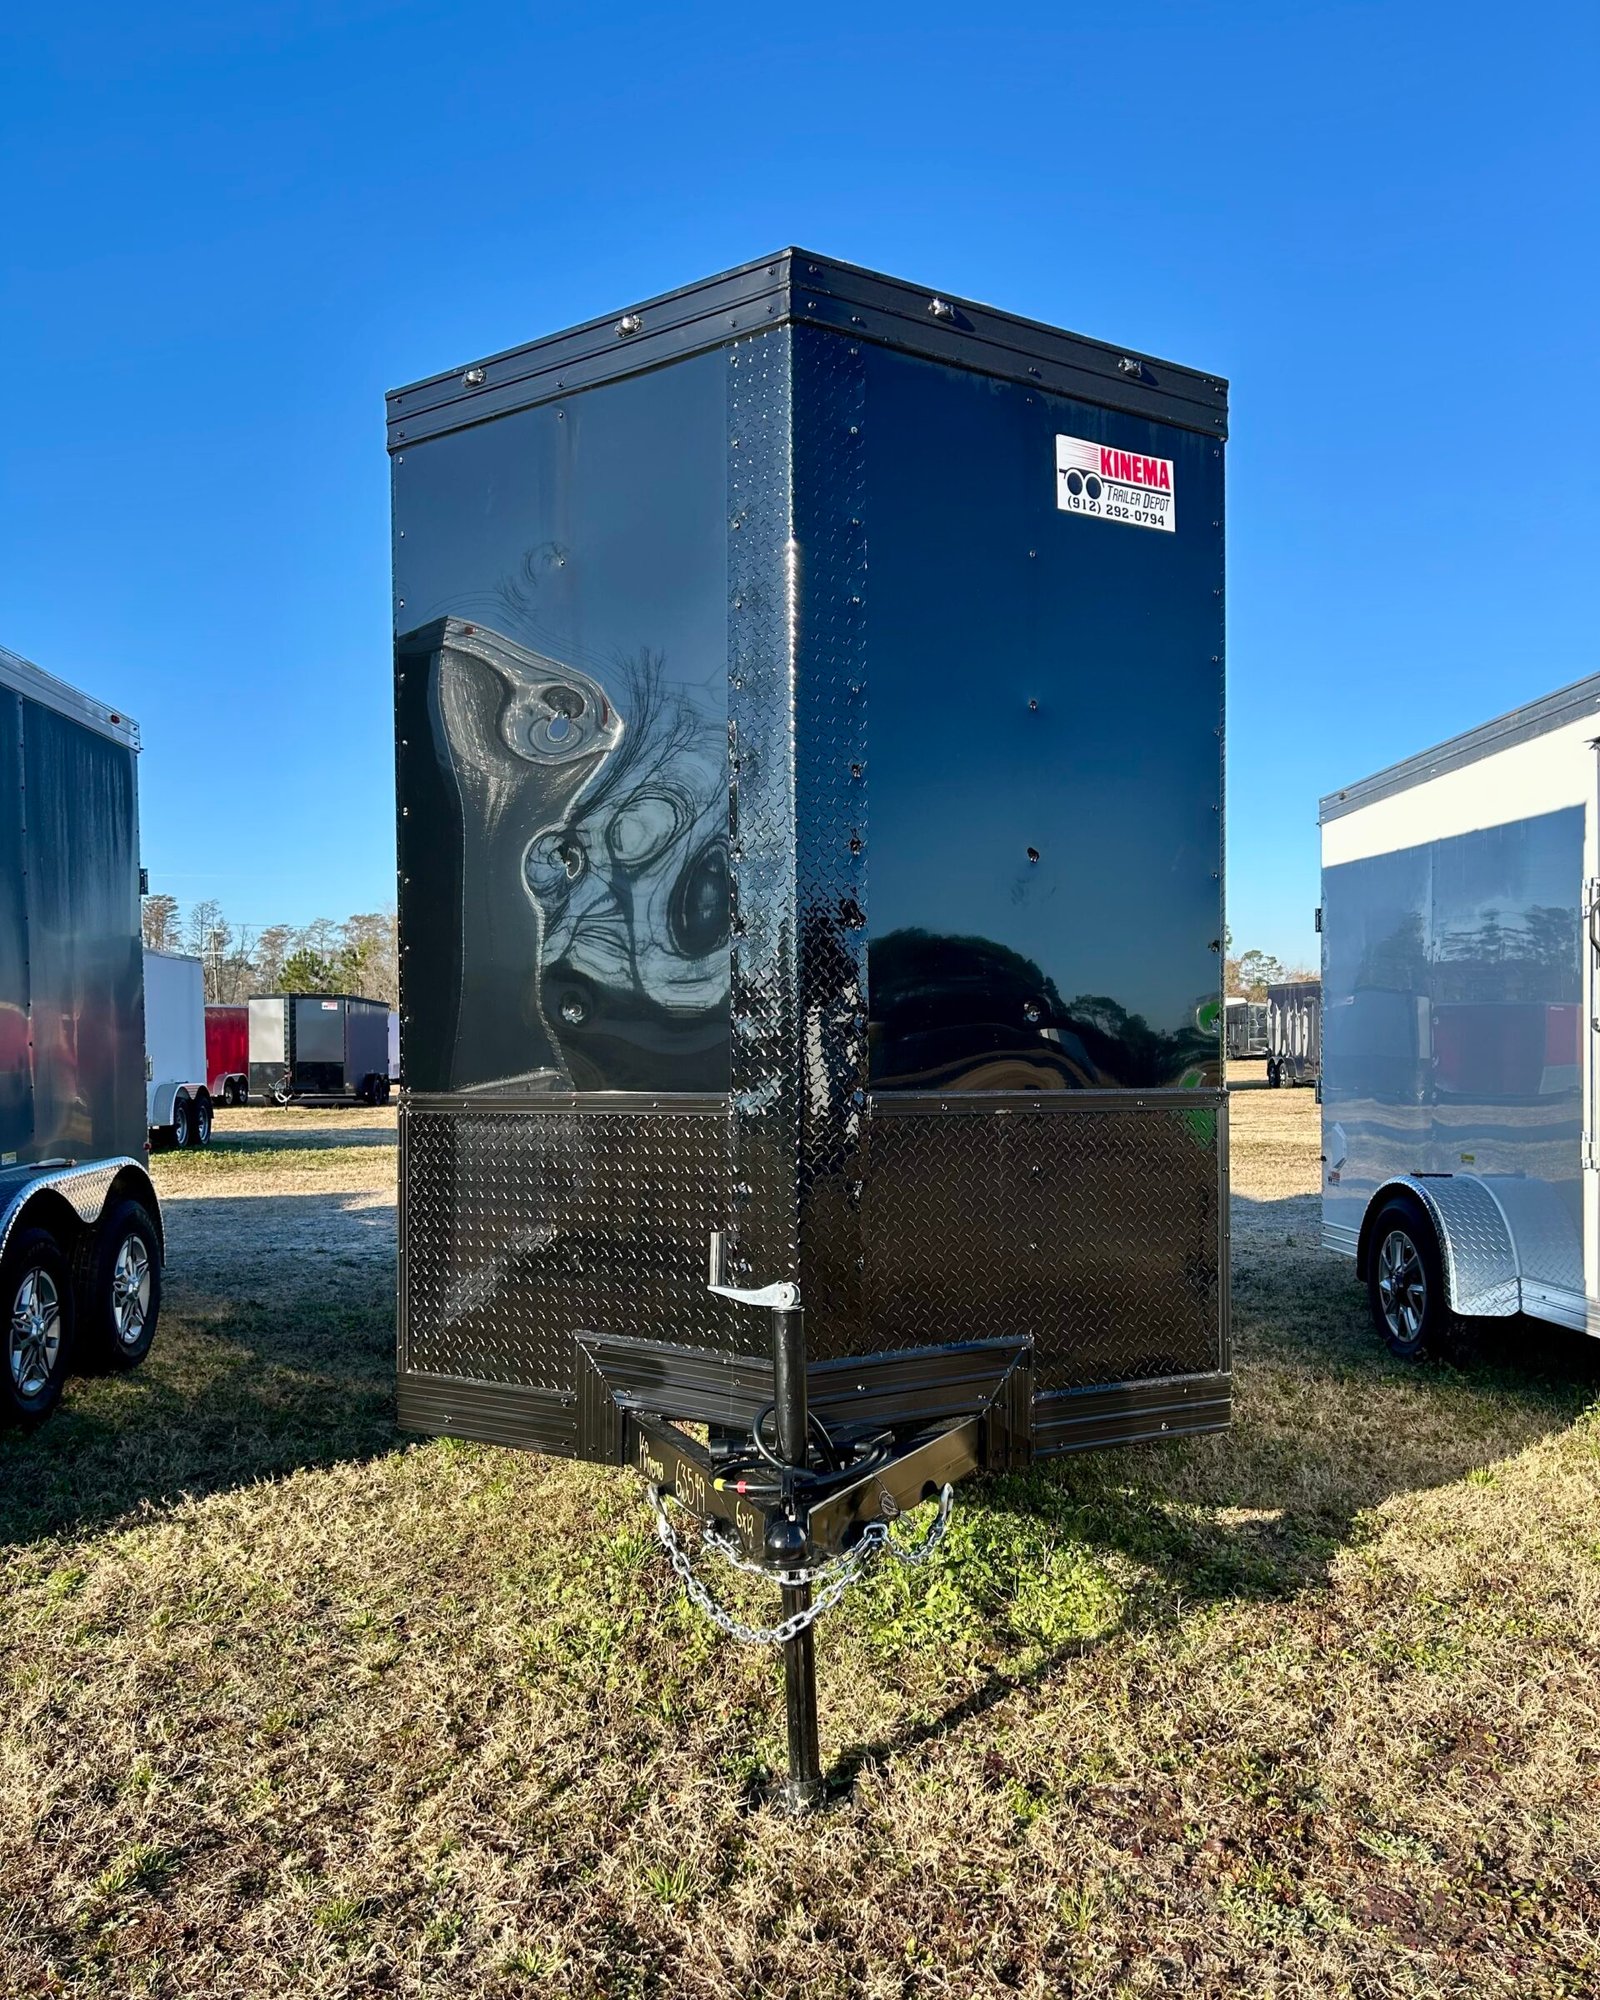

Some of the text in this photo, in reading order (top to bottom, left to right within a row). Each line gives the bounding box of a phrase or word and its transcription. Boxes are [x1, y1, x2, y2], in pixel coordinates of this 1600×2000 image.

[1100, 447, 1170, 490] KINEMA
[1067, 495, 1165, 526] (912) 292-0794
[1107, 485, 1170, 512] TRAILER DEPOT
